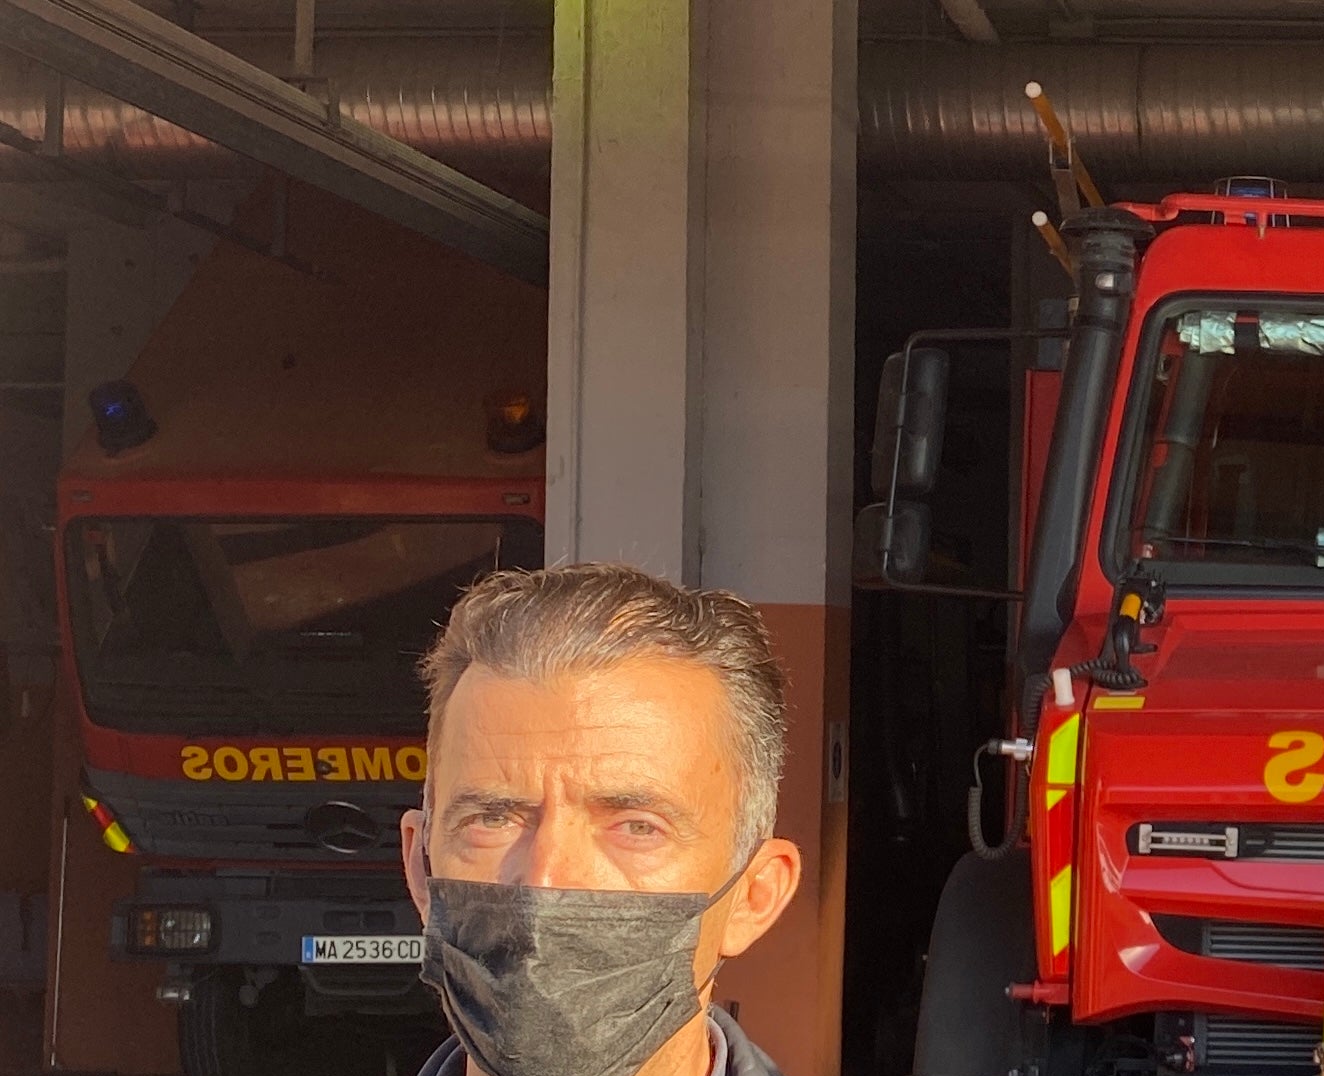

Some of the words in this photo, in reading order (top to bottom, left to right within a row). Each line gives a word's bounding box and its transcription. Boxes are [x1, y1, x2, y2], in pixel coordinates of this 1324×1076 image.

[315, 939, 338, 960] MA
[342, 939, 394, 960] 2536
[397, 939, 421, 960] CD
